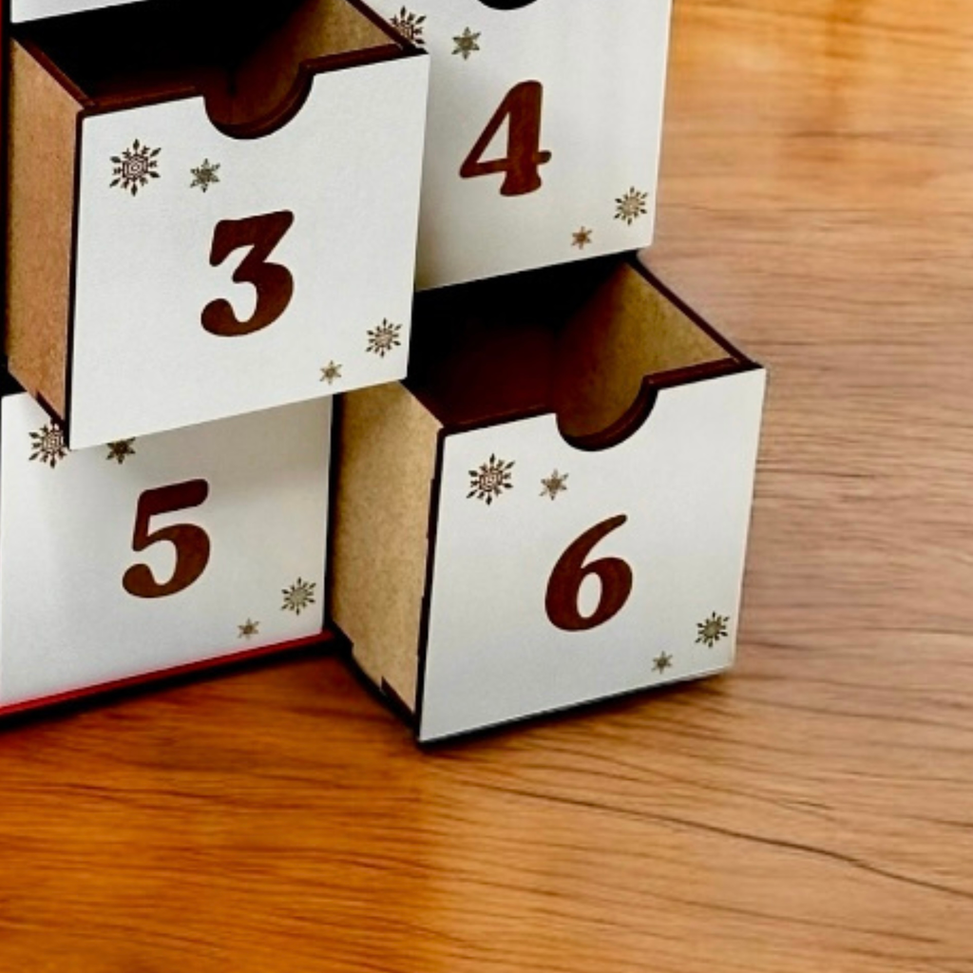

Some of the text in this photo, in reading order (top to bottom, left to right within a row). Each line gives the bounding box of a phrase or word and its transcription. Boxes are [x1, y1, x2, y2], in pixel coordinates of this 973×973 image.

[459, 81, 551, 196] 4
[201, 210, 294, 337] 3
[123, 479, 210, 598] 5
[545, 515, 632, 631] 6
